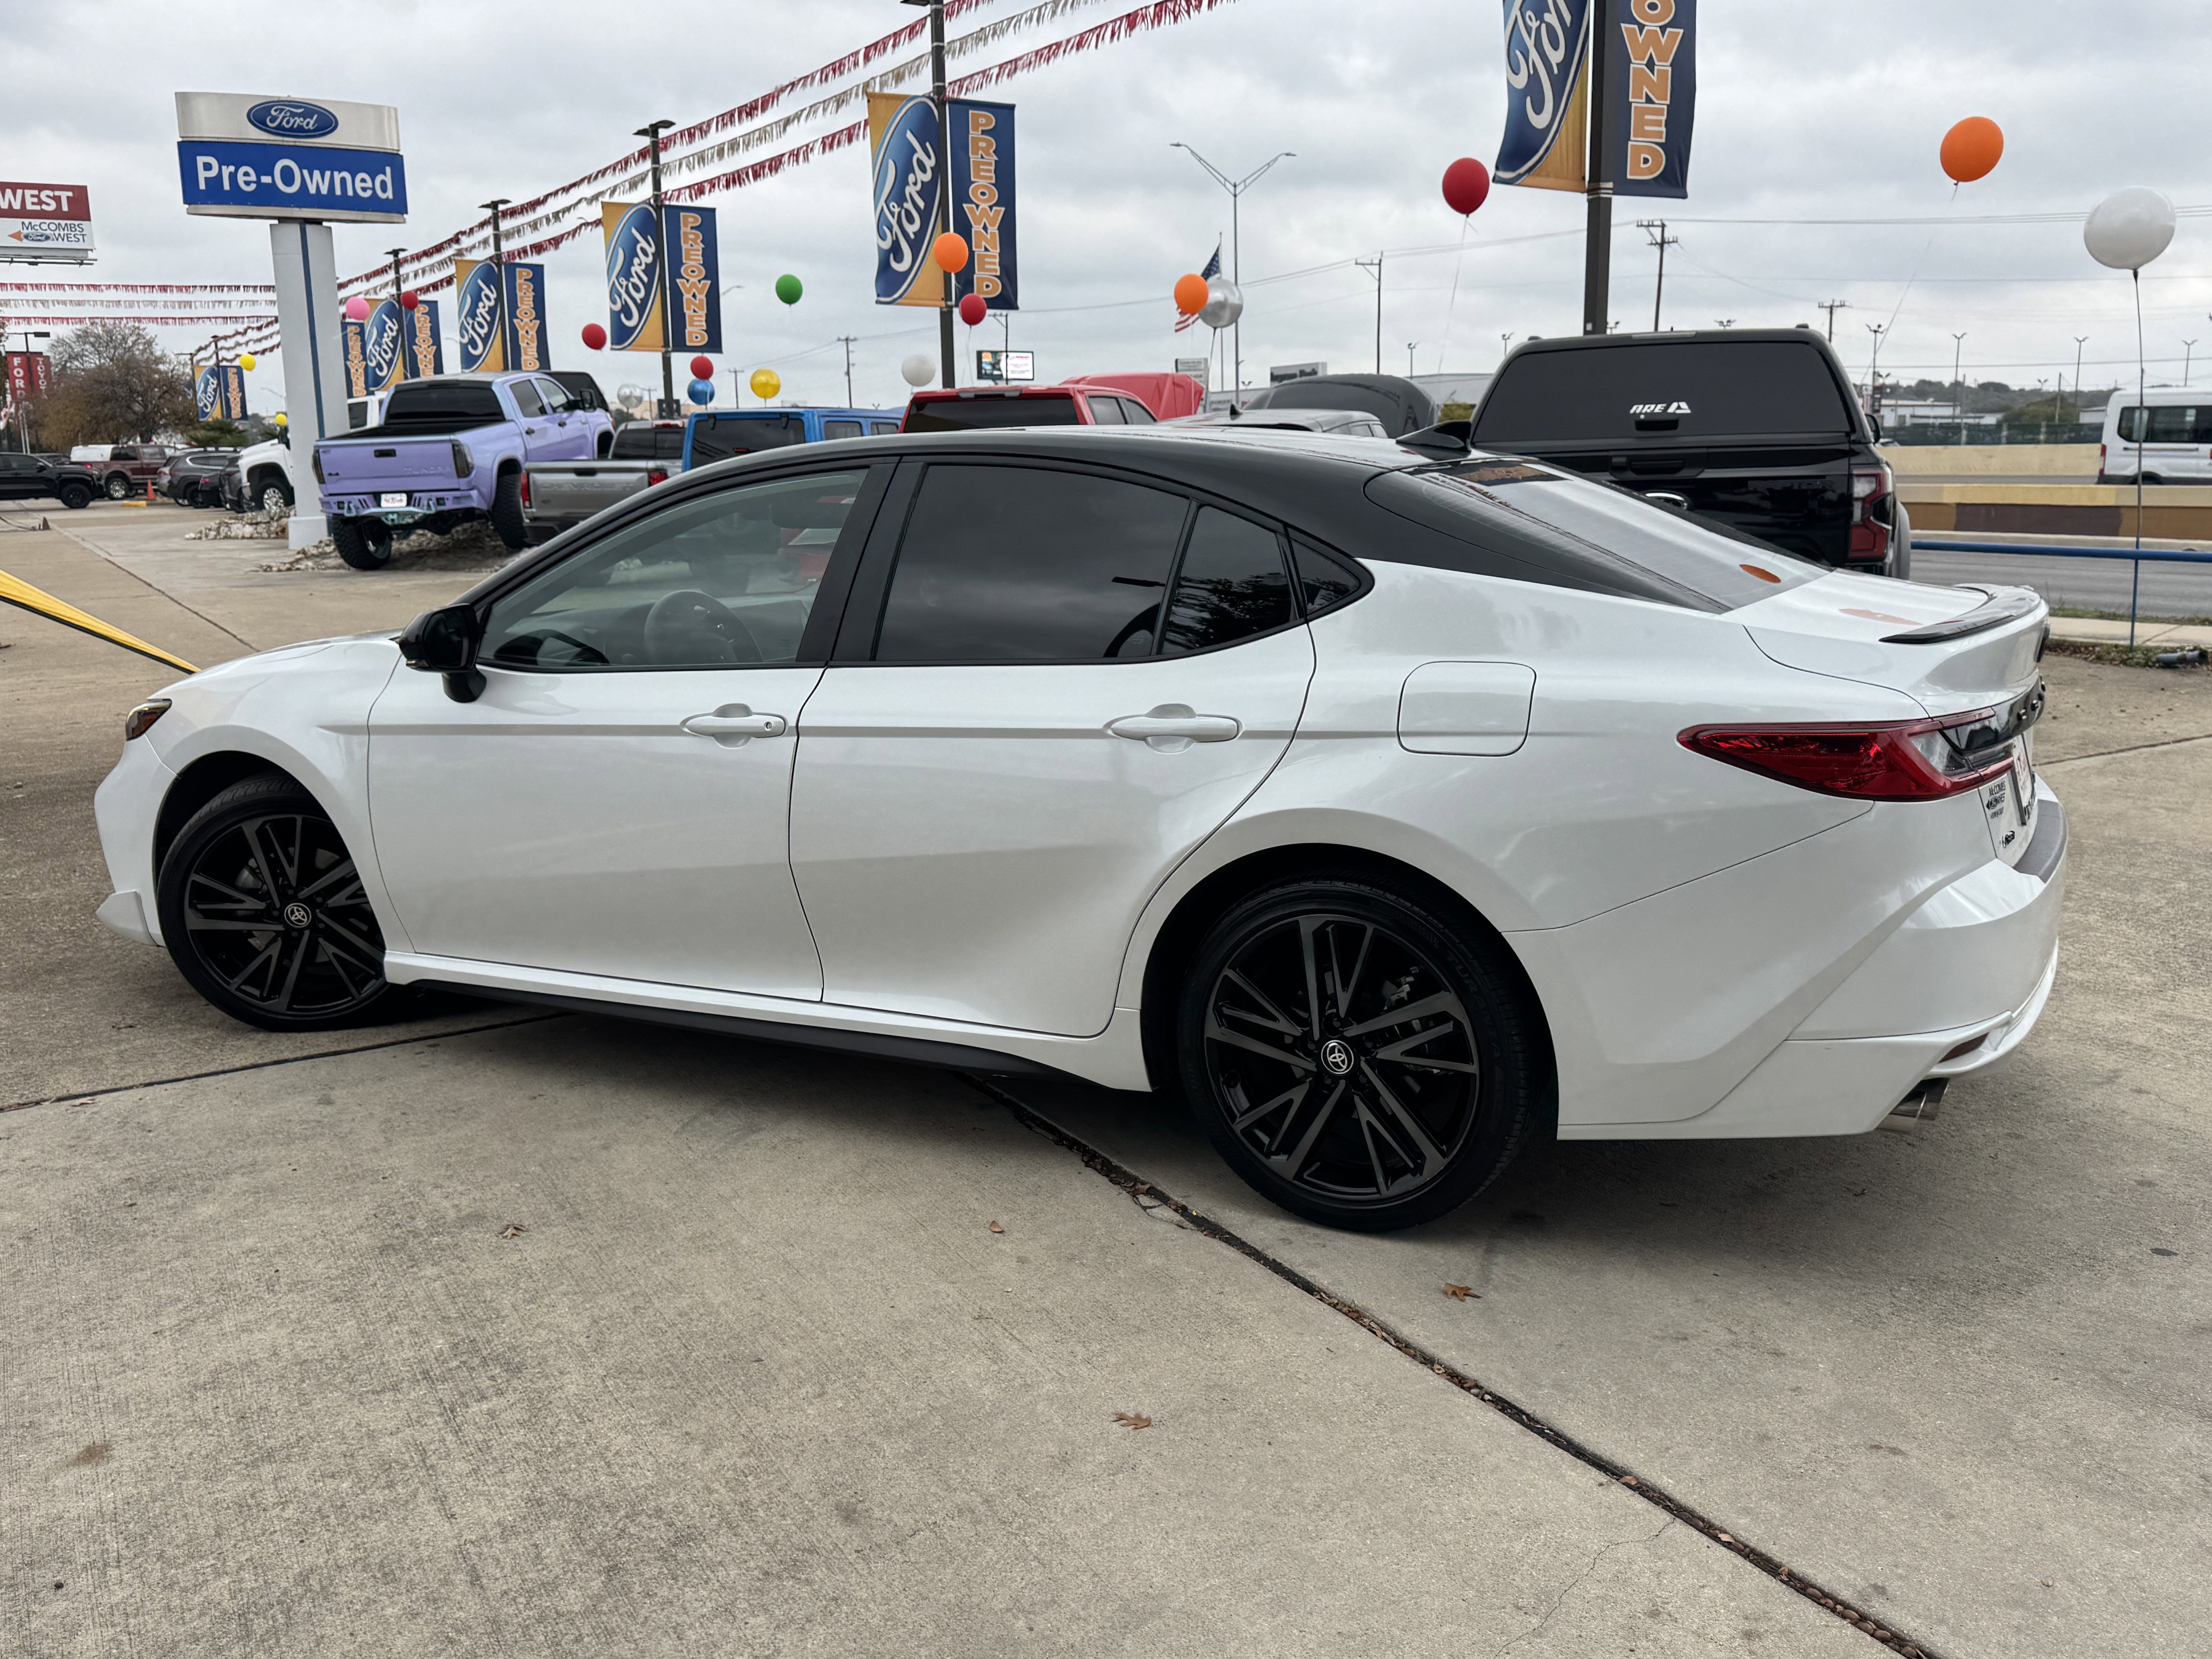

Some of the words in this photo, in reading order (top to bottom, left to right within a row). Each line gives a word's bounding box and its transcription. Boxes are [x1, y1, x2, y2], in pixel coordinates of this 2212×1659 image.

[266, 105, 318, 130] Ford
[1621, 0, 1684, 180] OWNED
[0, 189, 73, 211] WEST
[196, 156, 393, 199] Pre-Owned
[876, 130, 936, 271] Ford
[963, 110, 1005, 297] PREOWNED
[21, 222, 84, 233] McCOMBS
[53, 233, 86, 242] WEST
[609, 227, 656, 327] Ford
[676, 212, 711, 346] PREOWNED
[368, 313, 398, 377] Ford
[412, 304, 437, 376] PREOWNE
[459, 278, 497, 356] Ford
[513, 268, 540, 371] PREOWNED
[13, 357, 26, 399] FORD
[197, 374, 218, 412] Ford
